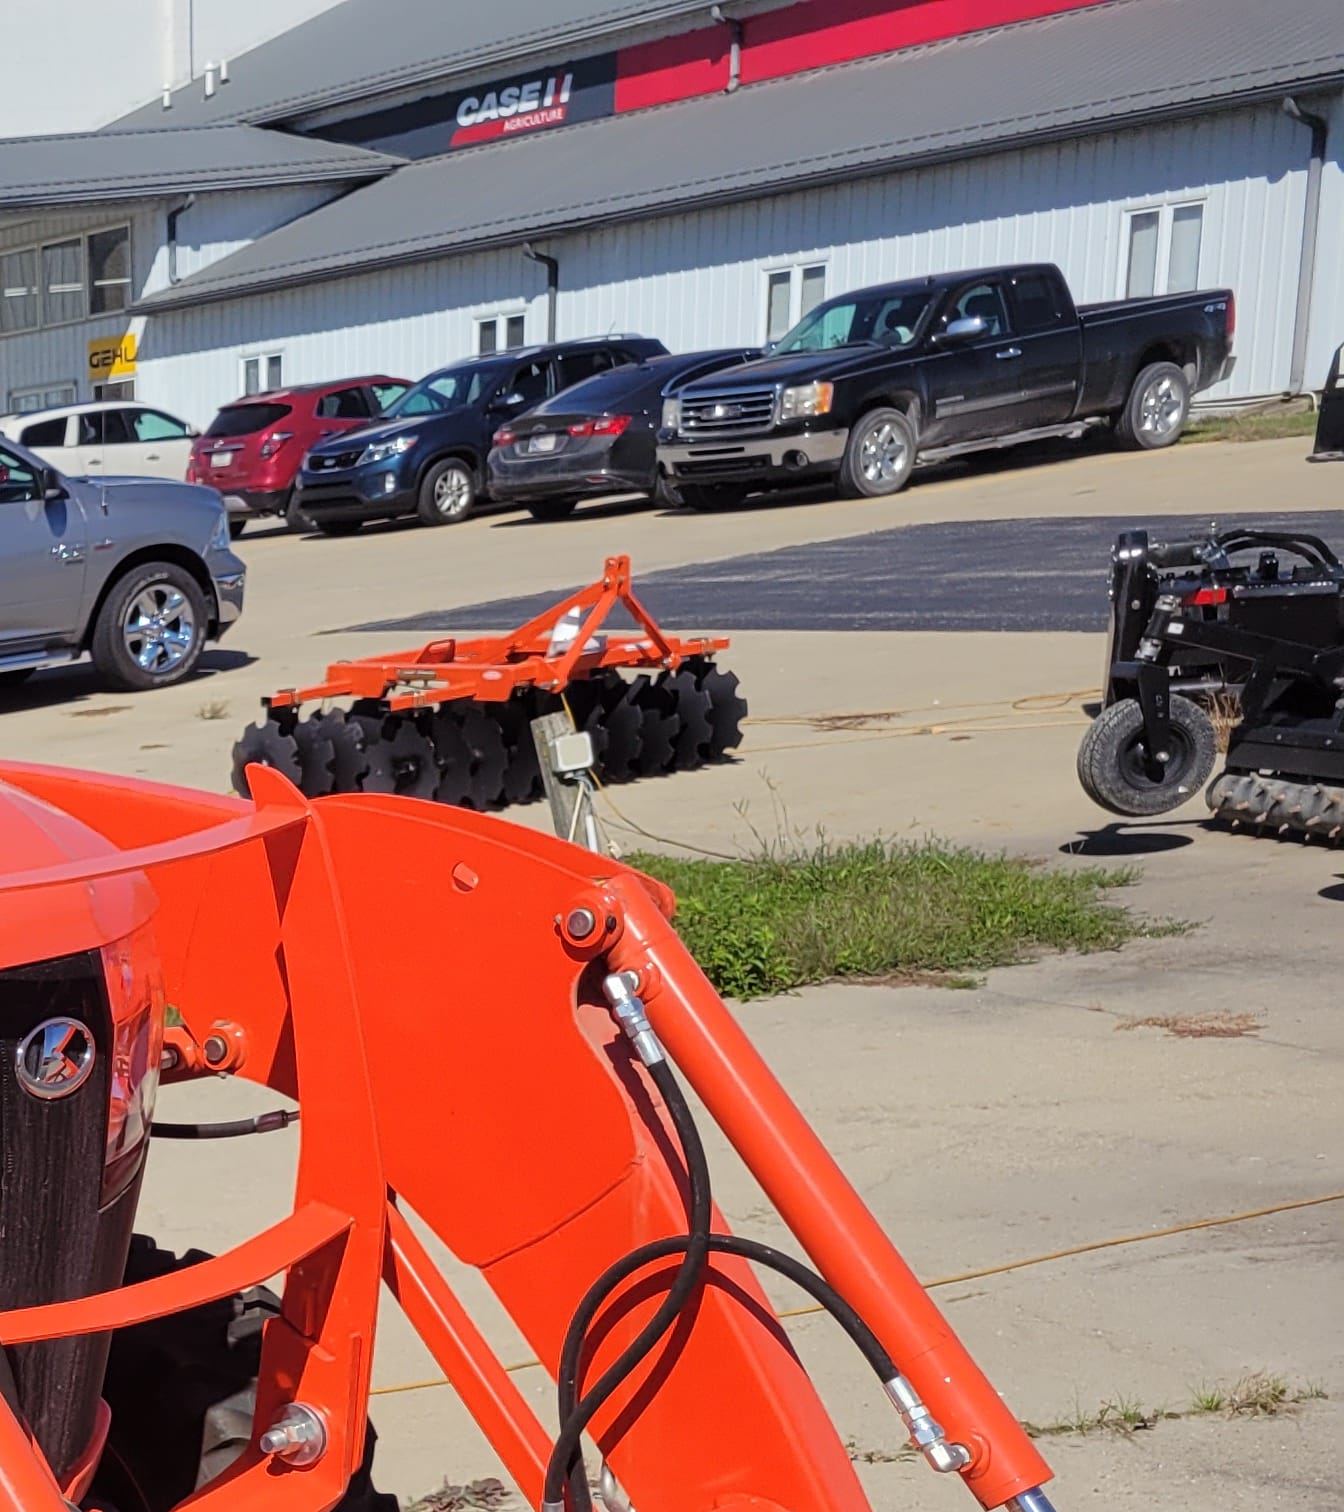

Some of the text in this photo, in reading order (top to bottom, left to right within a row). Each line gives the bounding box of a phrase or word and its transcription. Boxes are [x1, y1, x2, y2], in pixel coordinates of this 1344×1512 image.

[456, 80, 543, 127] CASE
[503, 107, 564, 132] AGRICULTURE
[1203, 302, 1227, 313] 44
[89, 346, 137, 369] GEHL
